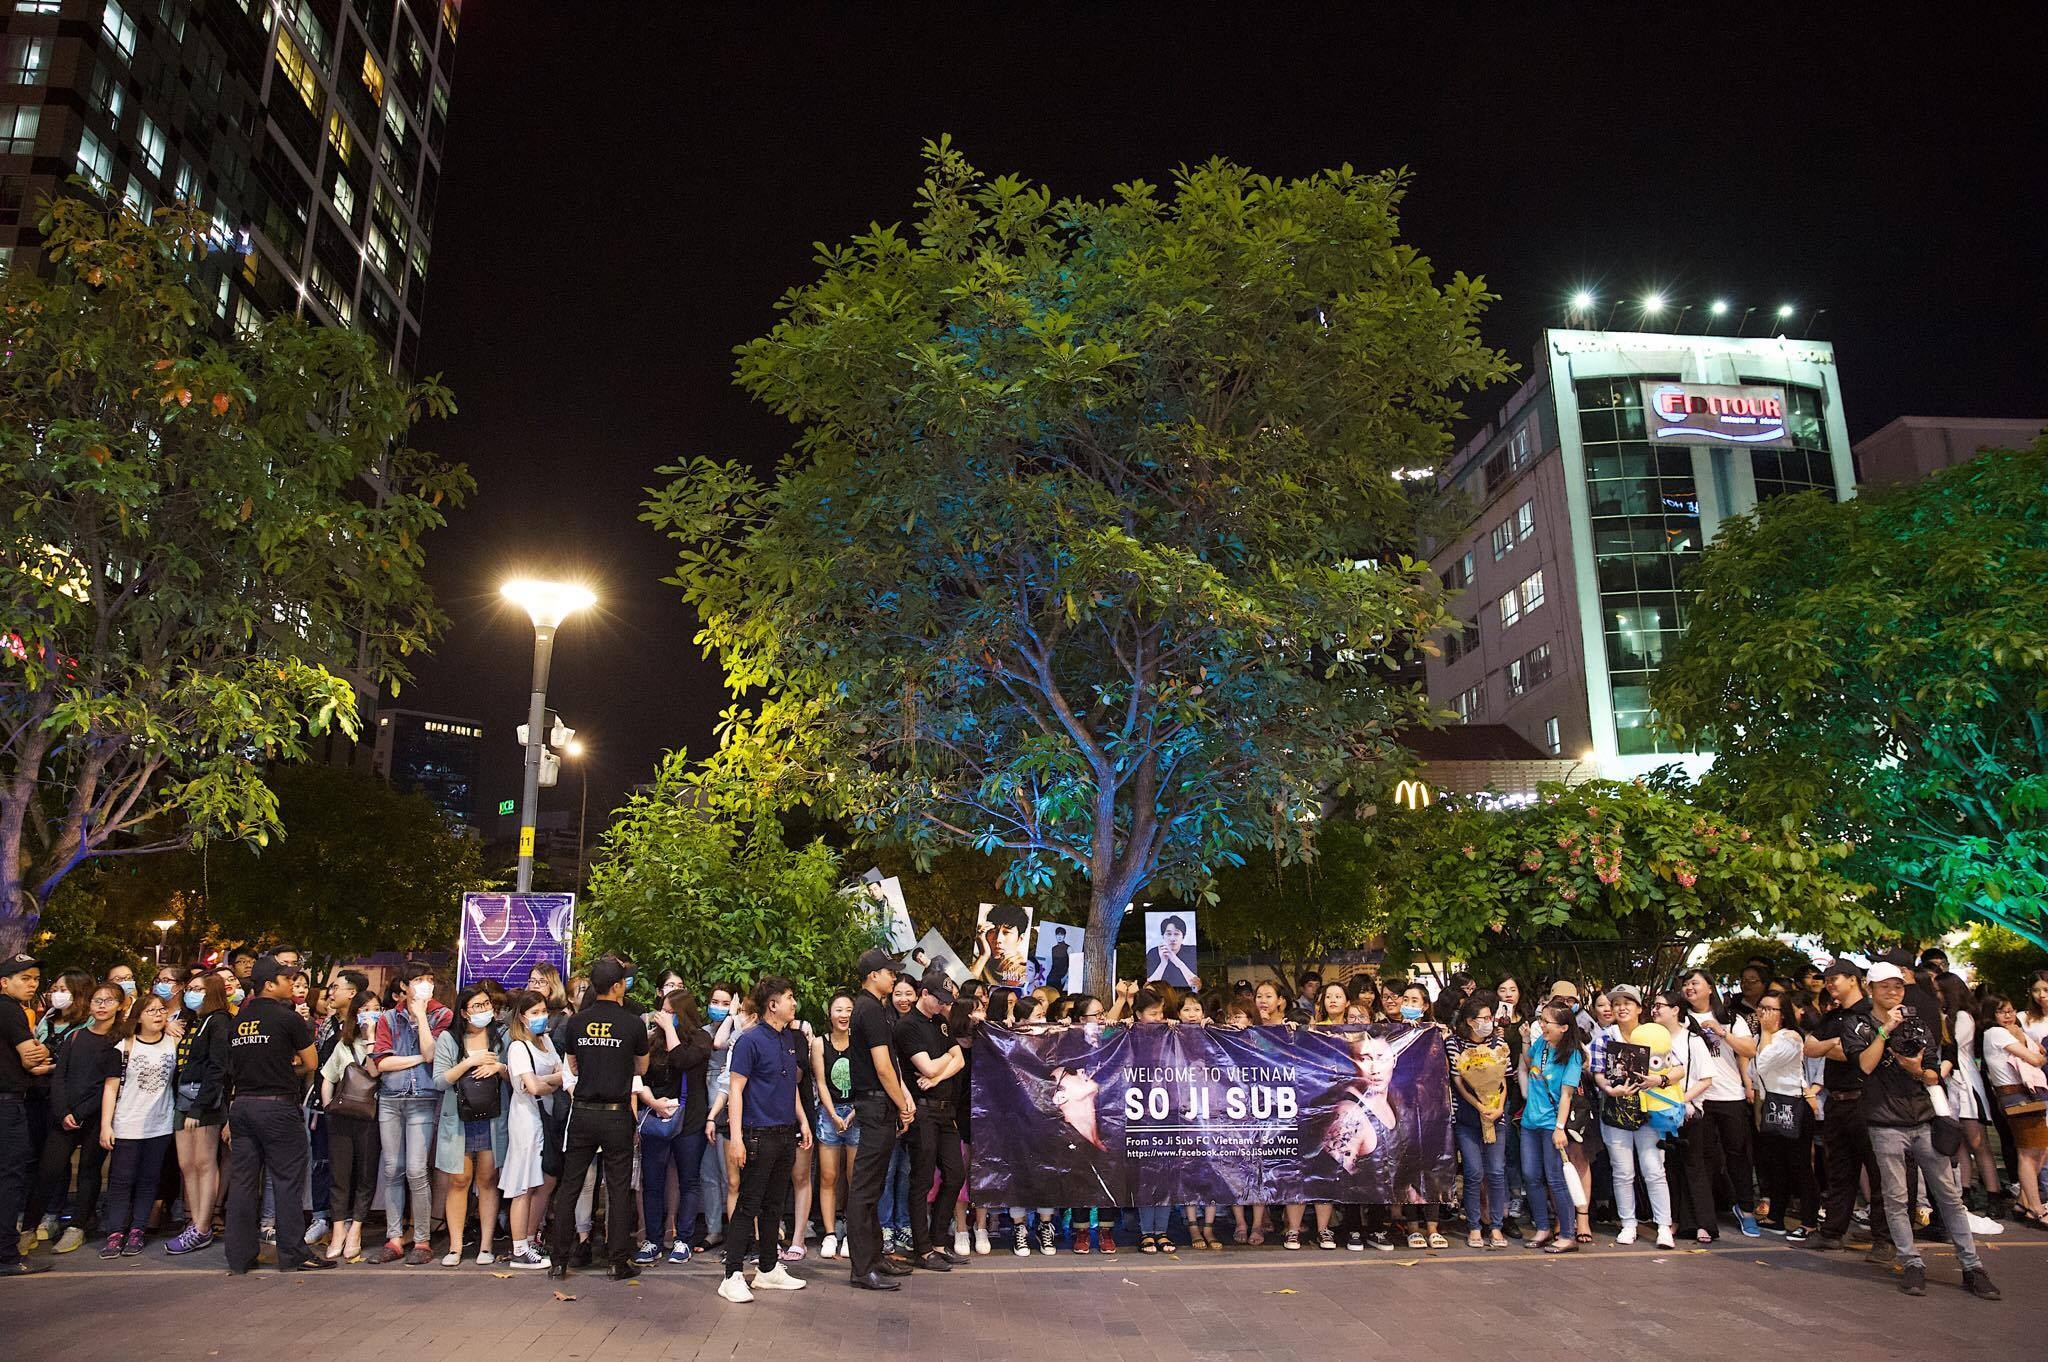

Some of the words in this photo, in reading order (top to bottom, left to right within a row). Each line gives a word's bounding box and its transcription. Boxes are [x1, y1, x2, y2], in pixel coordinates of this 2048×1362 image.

[1661, 393, 1782, 417] FIDITOUR
[237, 1020, 260, 1036] GE
[586, 1022, 613, 1037] GE
[231, 1035, 270, 1047] SECURITY
[577, 1037, 622, 1047] SECURITY
[1124, 1068, 1197, 1082] WELCOME
[1203, 1067, 1220, 1081] TO
[1227, 1067, 1296, 1081] VIETNAM
[1125, 1087, 1170, 1120] SO
[1184, 1087, 1210, 1119] JI
[1226, 1086, 1298, 1119] SUB
[1126, 1137, 1149, 1146] From
[1152, 1137, 1163, 1145] So
[1165, 1136, 1173, 1145] Ji
[1176, 1136, 1193, 1145] Sub
[1196, 1136, 1209, 1145] FC
[1213, 1136, 1252, 1145] Vietnam
[1262, 1136, 1274, 1145] So
[1277, 1136, 1298, 1145] Won
[1127, 1147, 1297, 1159] https://www.facebook.com/SoJiSubVNFC
